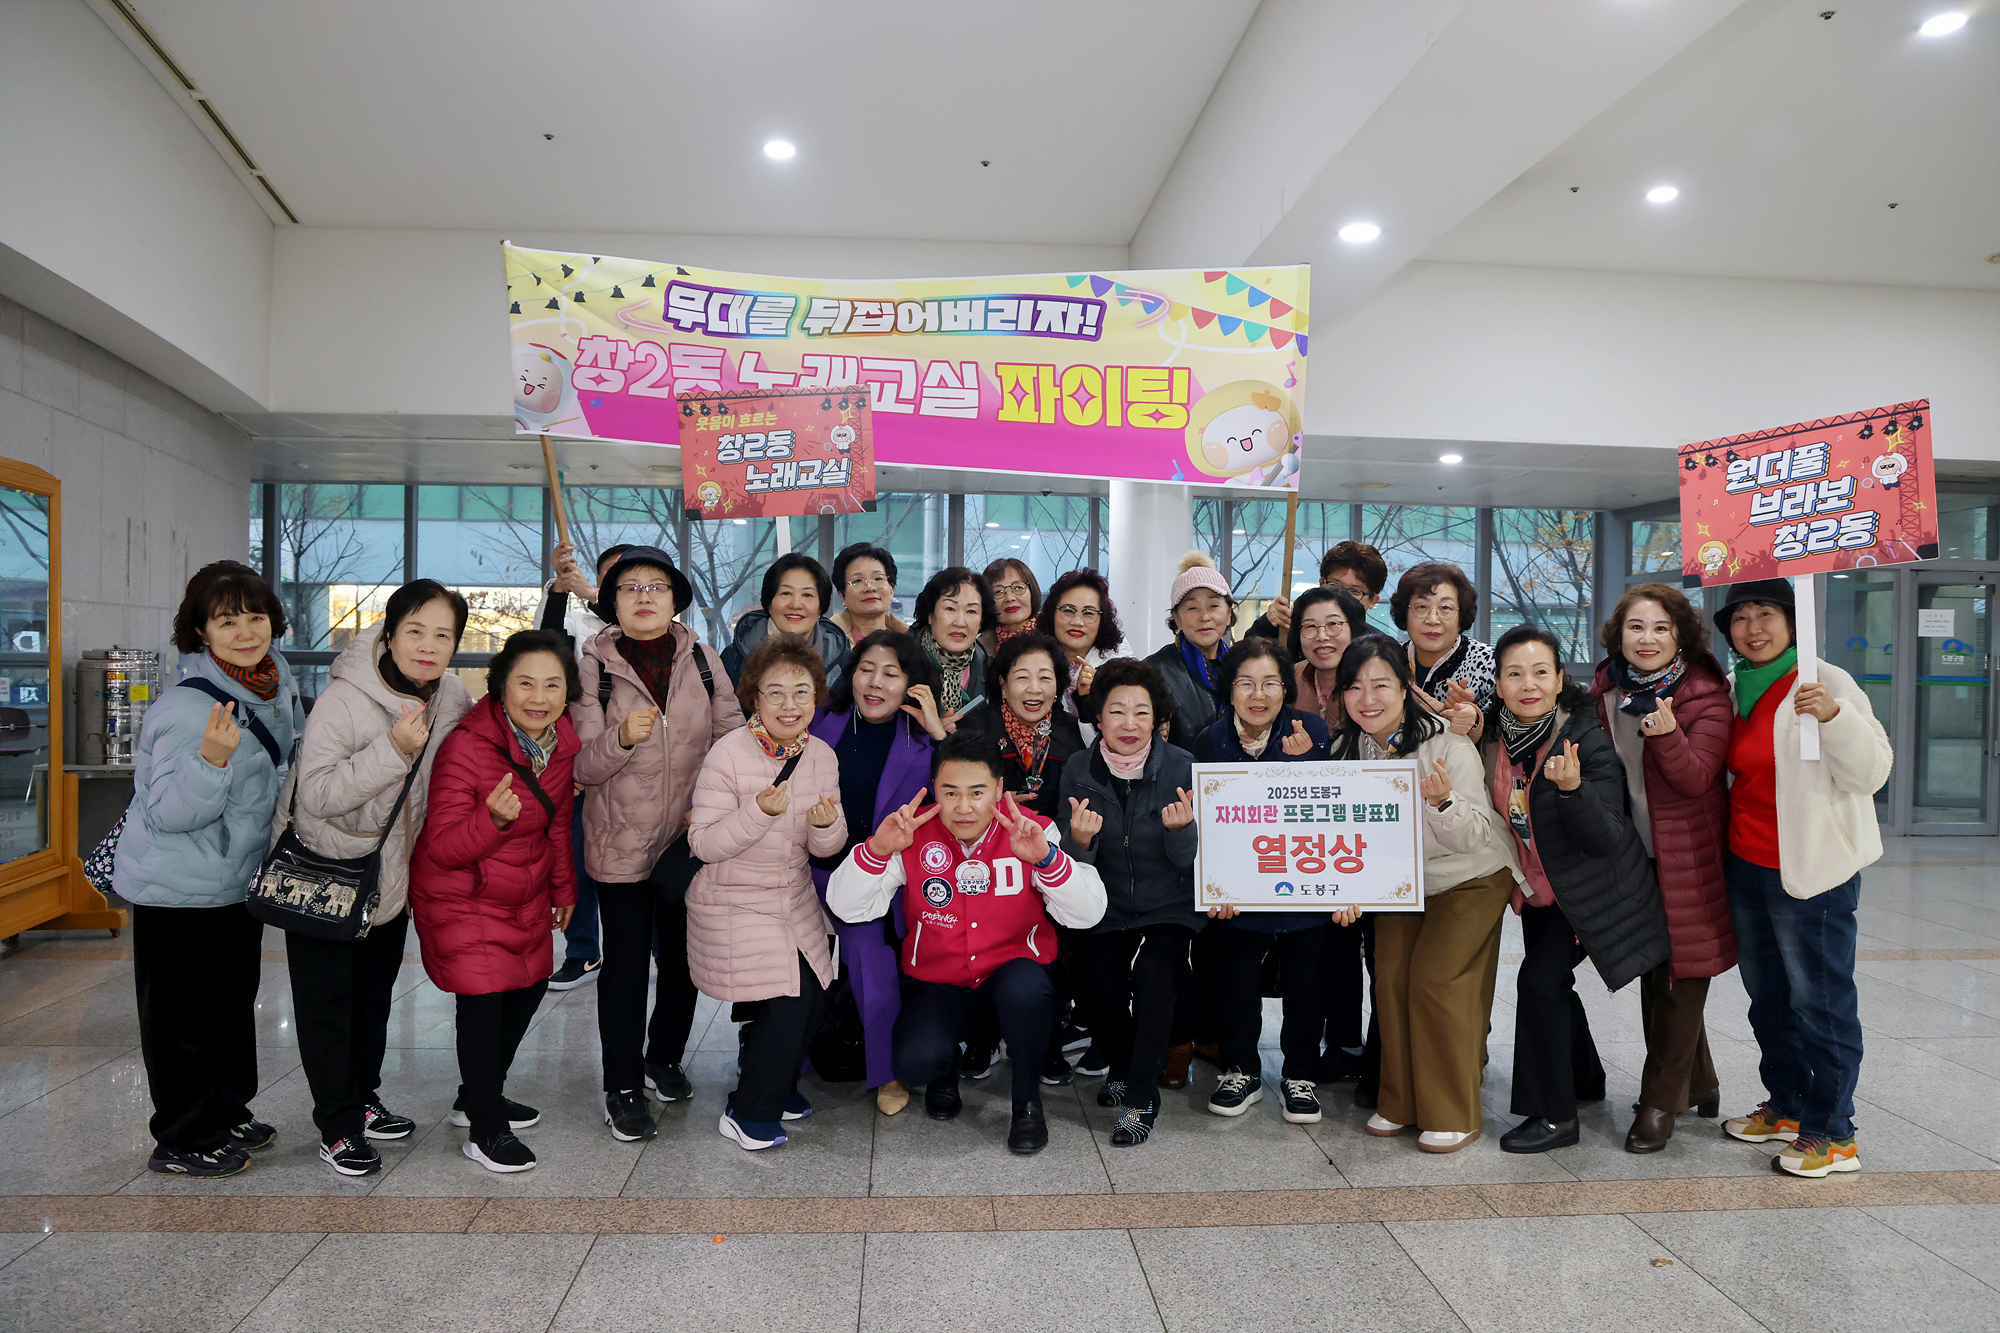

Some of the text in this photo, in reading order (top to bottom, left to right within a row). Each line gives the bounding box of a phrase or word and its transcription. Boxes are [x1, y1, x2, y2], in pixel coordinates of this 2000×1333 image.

[666, 282, 1101, 338] 무대를 뒤집어버리자!
[572, 335, 1191, 429] 창2동 노래교실 파이팅
[696, 411, 778, 432] 웃음이 흐르는
[717, 429, 797, 465] 창2동
[744, 457, 852, 494] 노래교실
[1725, 441, 1831, 495] 원더풀
[1749, 475, 1858, 527] 브라보
[1773, 510, 1880, 561] 창2동
[1267, 786, 1342, 800] 2025년 도봉구
[1215, 803, 1400, 824] 자치회관 프로그램 발표회
[1252, 834, 1367, 874] 열정상
[993, 857, 1024, 896] D
[1300, 884, 1340, 896] 도봉구
